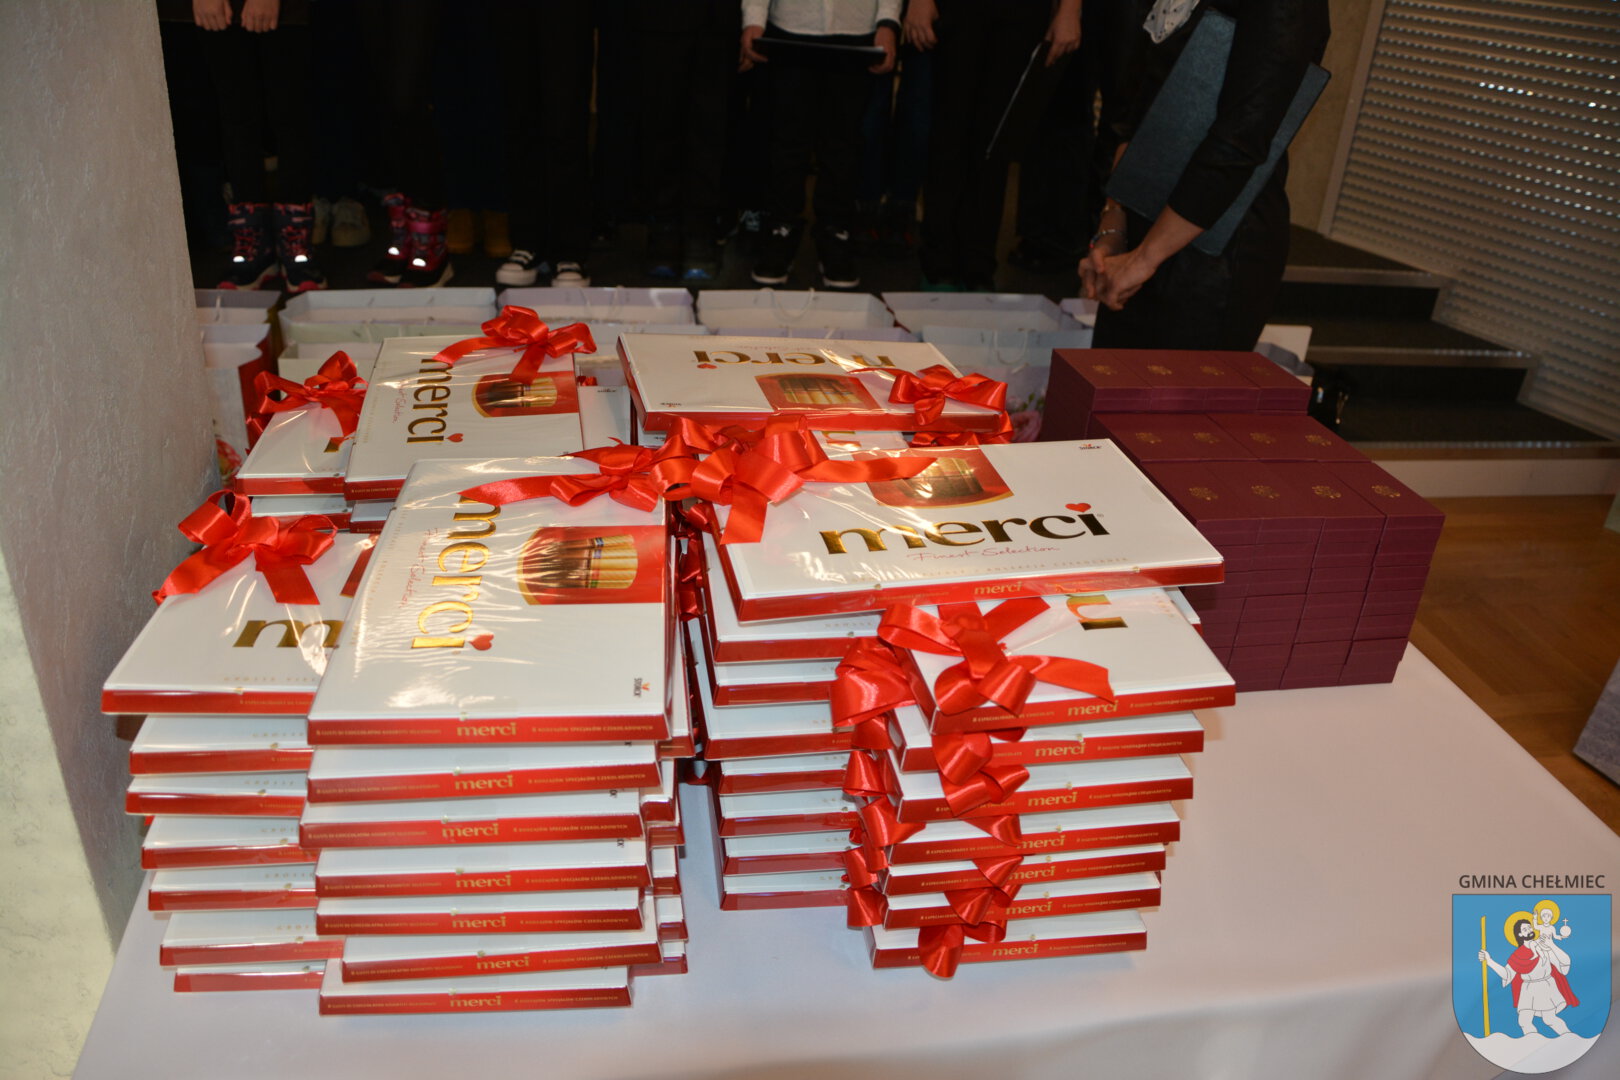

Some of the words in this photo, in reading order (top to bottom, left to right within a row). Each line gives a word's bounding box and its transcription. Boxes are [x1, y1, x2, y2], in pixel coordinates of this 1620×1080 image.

[407, 358, 464, 443] merci
[818, 502, 1110, 555] merci
[906, 547, 981, 562] Finest
[981, 544, 1061, 558] Selection
[411, 494, 501, 651] merci
[973, 580, 1023, 596] merci
[1067, 700, 1119, 717] merci
[457, 722, 517, 736] merci
[1034, 742, 1086, 758] merci
[454, 775, 514, 790] merci
[1028, 791, 1078, 807] merci
[442, 823, 499, 838] merci
[1016, 834, 1066, 849] merci
[1008, 865, 1056, 880] merci
[456, 874, 512, 888] merci
[1005, 901, 1053, 915] merci
[451, 916, 507, 928] merci
[993, 943, 1039, 957] merci
[476, 956, 530, 970] merci
[449, 995, 502, 1008] merci
